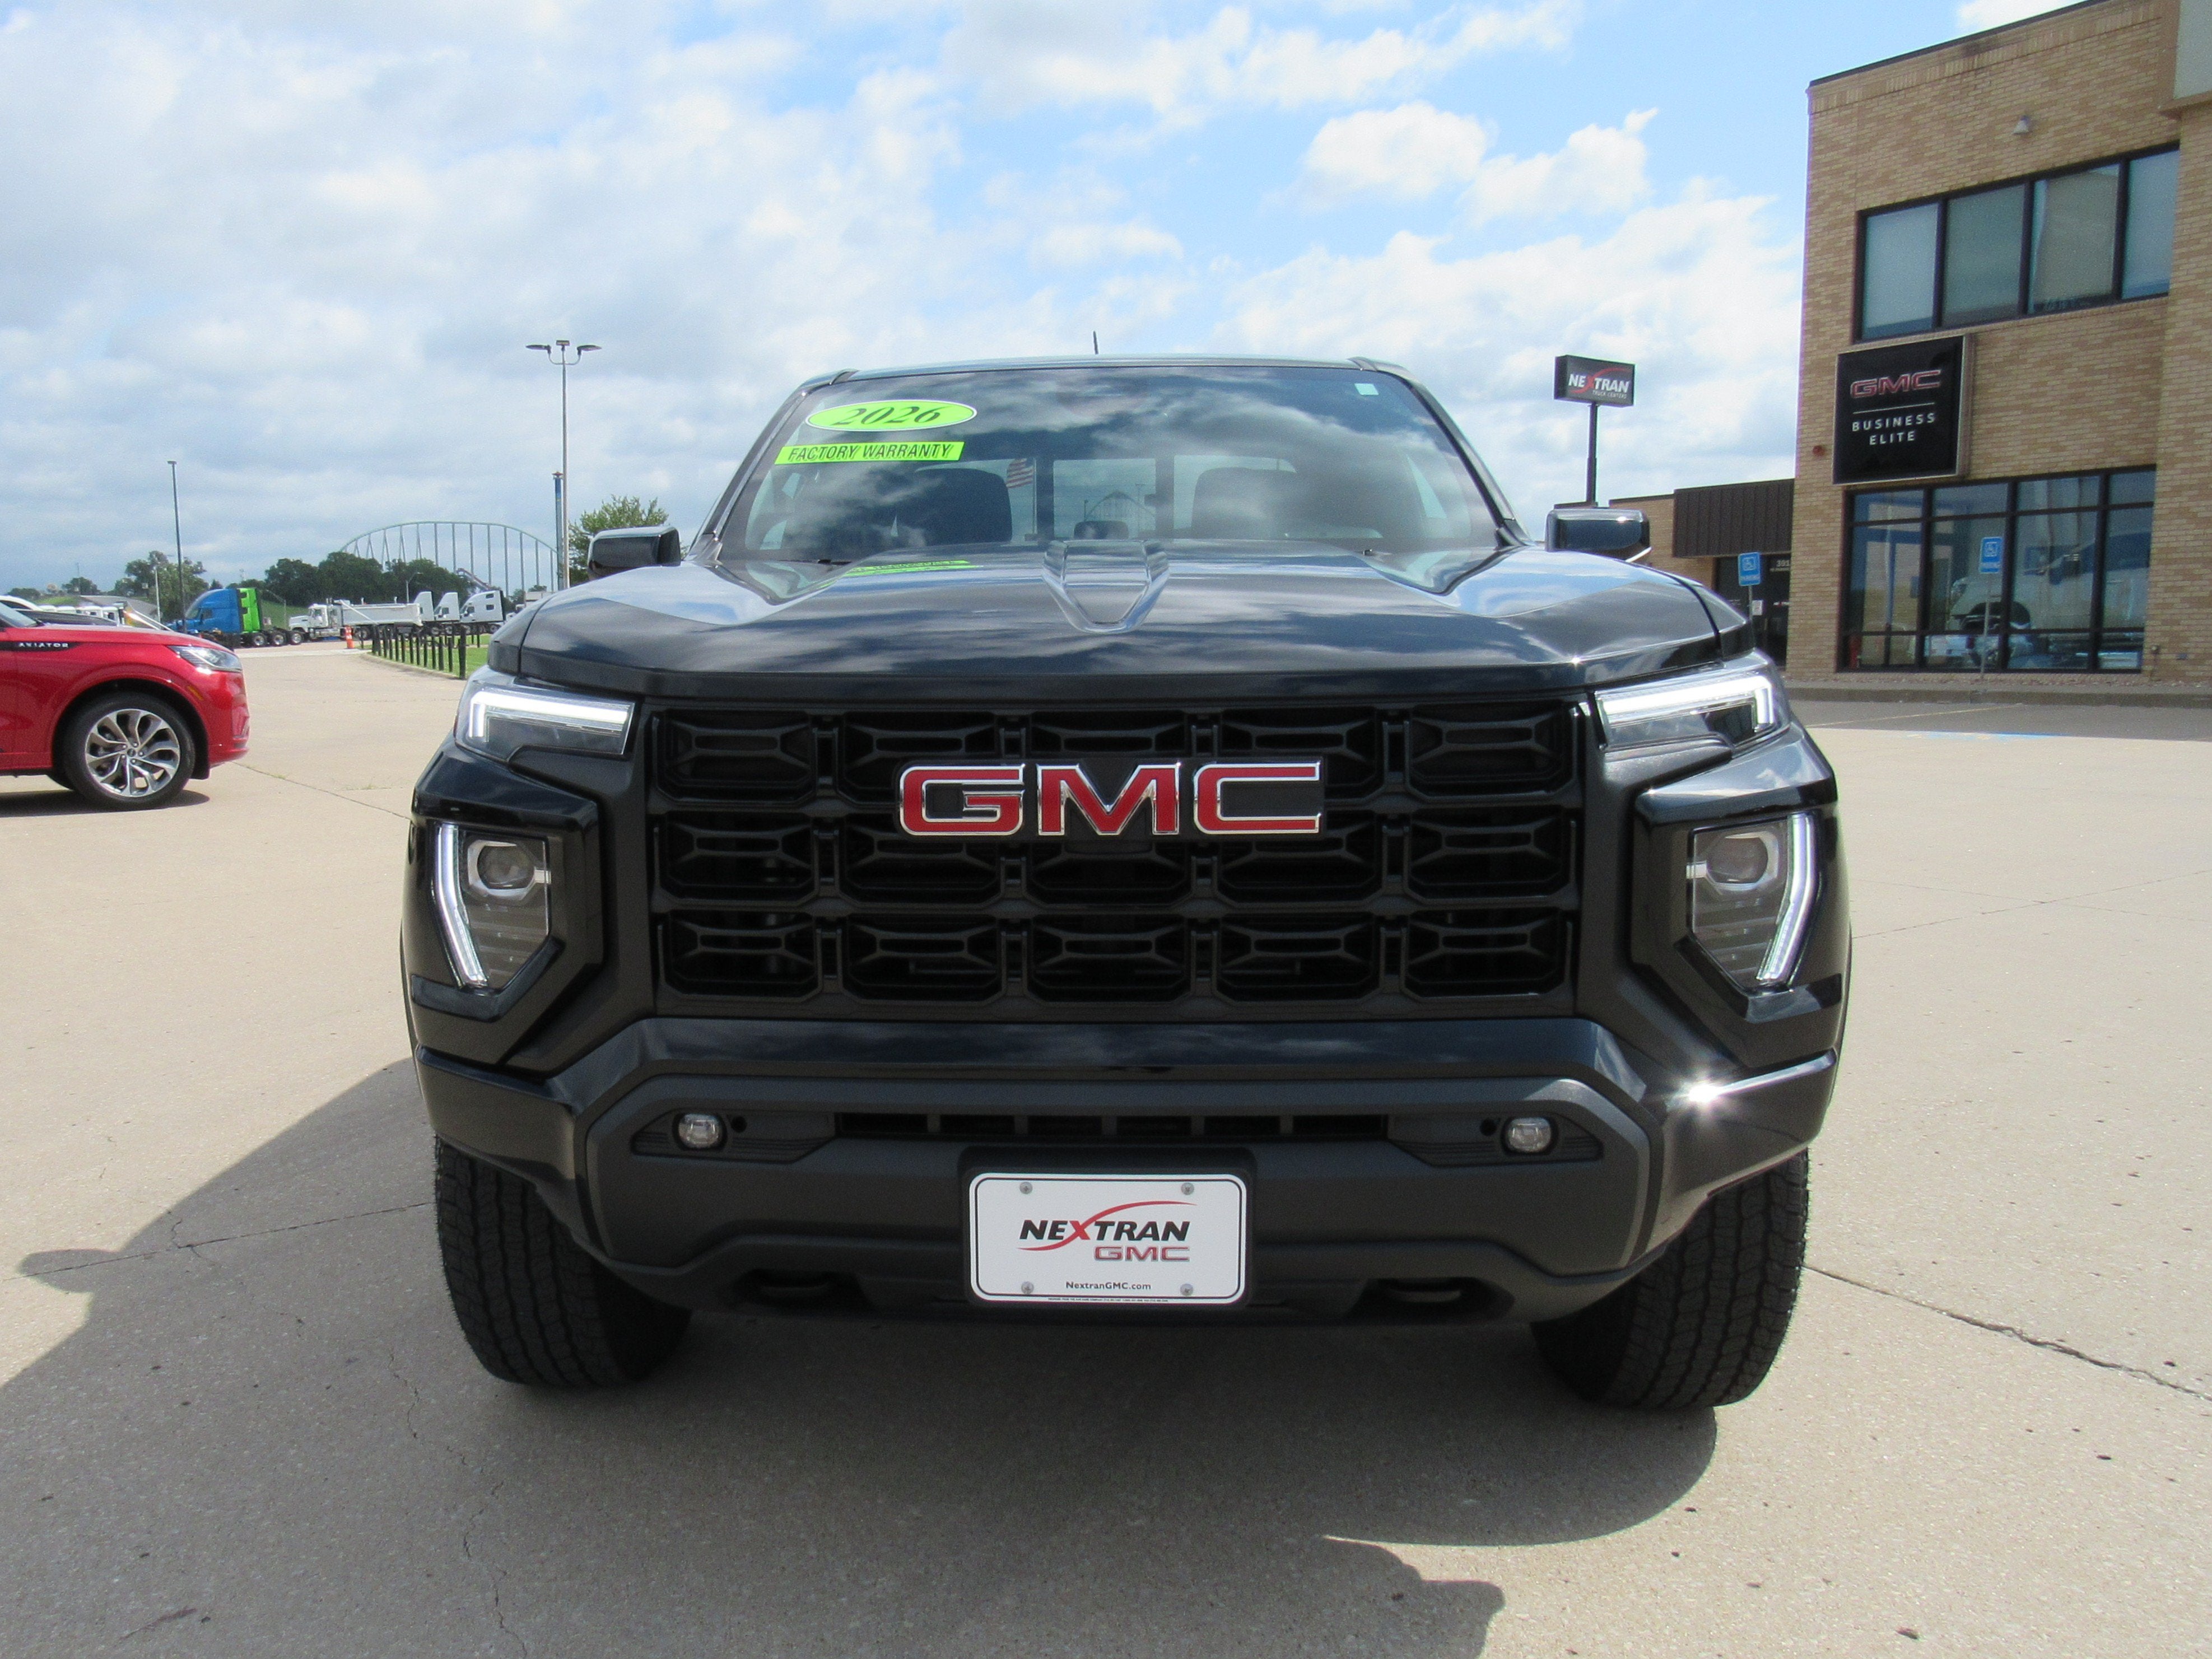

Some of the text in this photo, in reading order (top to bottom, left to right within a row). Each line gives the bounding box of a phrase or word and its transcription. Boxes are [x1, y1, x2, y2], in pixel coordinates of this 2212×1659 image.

[1568, 374, 1629, 393] NEXTRAN
[1850, 369, 1942, 398] GMC
[830, 406, 951, 427] 2026
[1852, 413, 1936, 431] BUSINESS
[1869, 431, 1916, 445] ELITE
[788, 444, 953, 462] FACTORY WARRANTY
[900, 762, 1321, 836] GMC
[1019, 1219, 1190, 1241] NEXTRAN
[1095, 1246, 1190, 1261] GMC
[1066, 1281, 1151, 1290] NextranGMC.com
